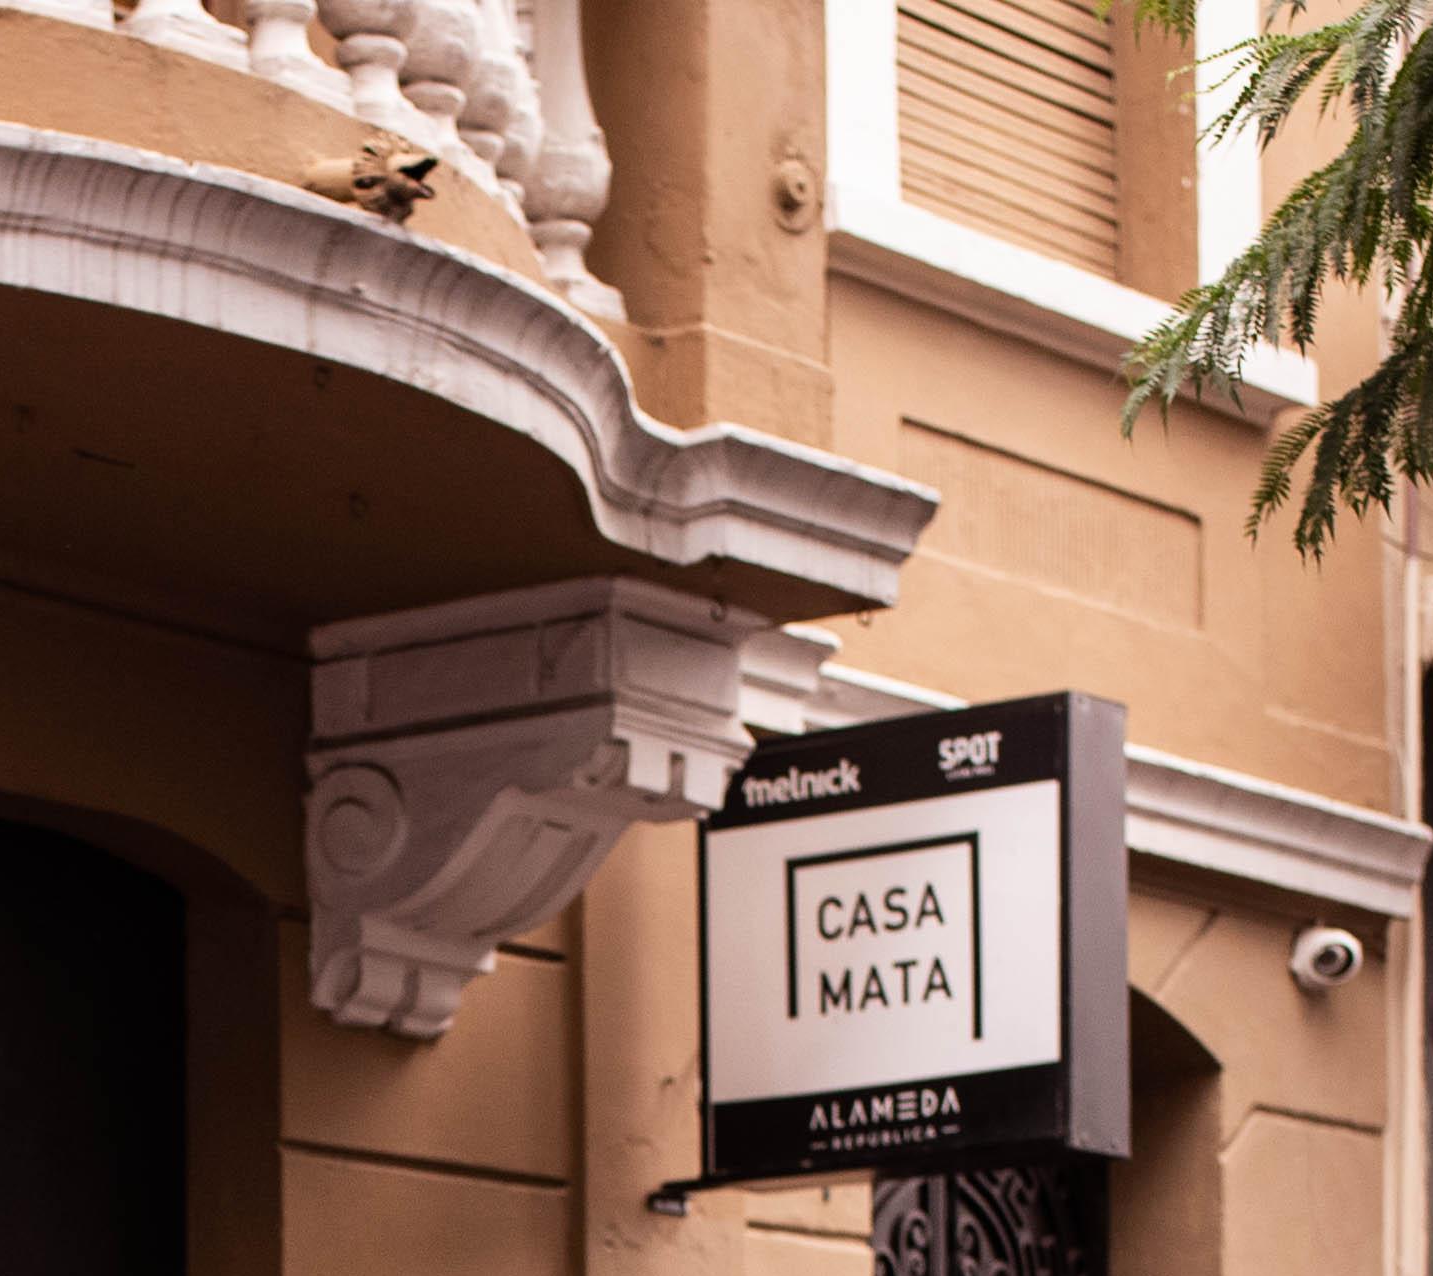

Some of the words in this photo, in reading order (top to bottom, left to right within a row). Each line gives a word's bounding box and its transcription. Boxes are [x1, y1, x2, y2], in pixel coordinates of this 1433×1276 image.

[938, 730, 1002, 771] SPOT
[742, 757, 861, 808] melnick
[817, 881, 945, 941] CASA
[819, 956, 953, 1015] MATA
[809, 1085, 961, 1131] ALAMEDA
